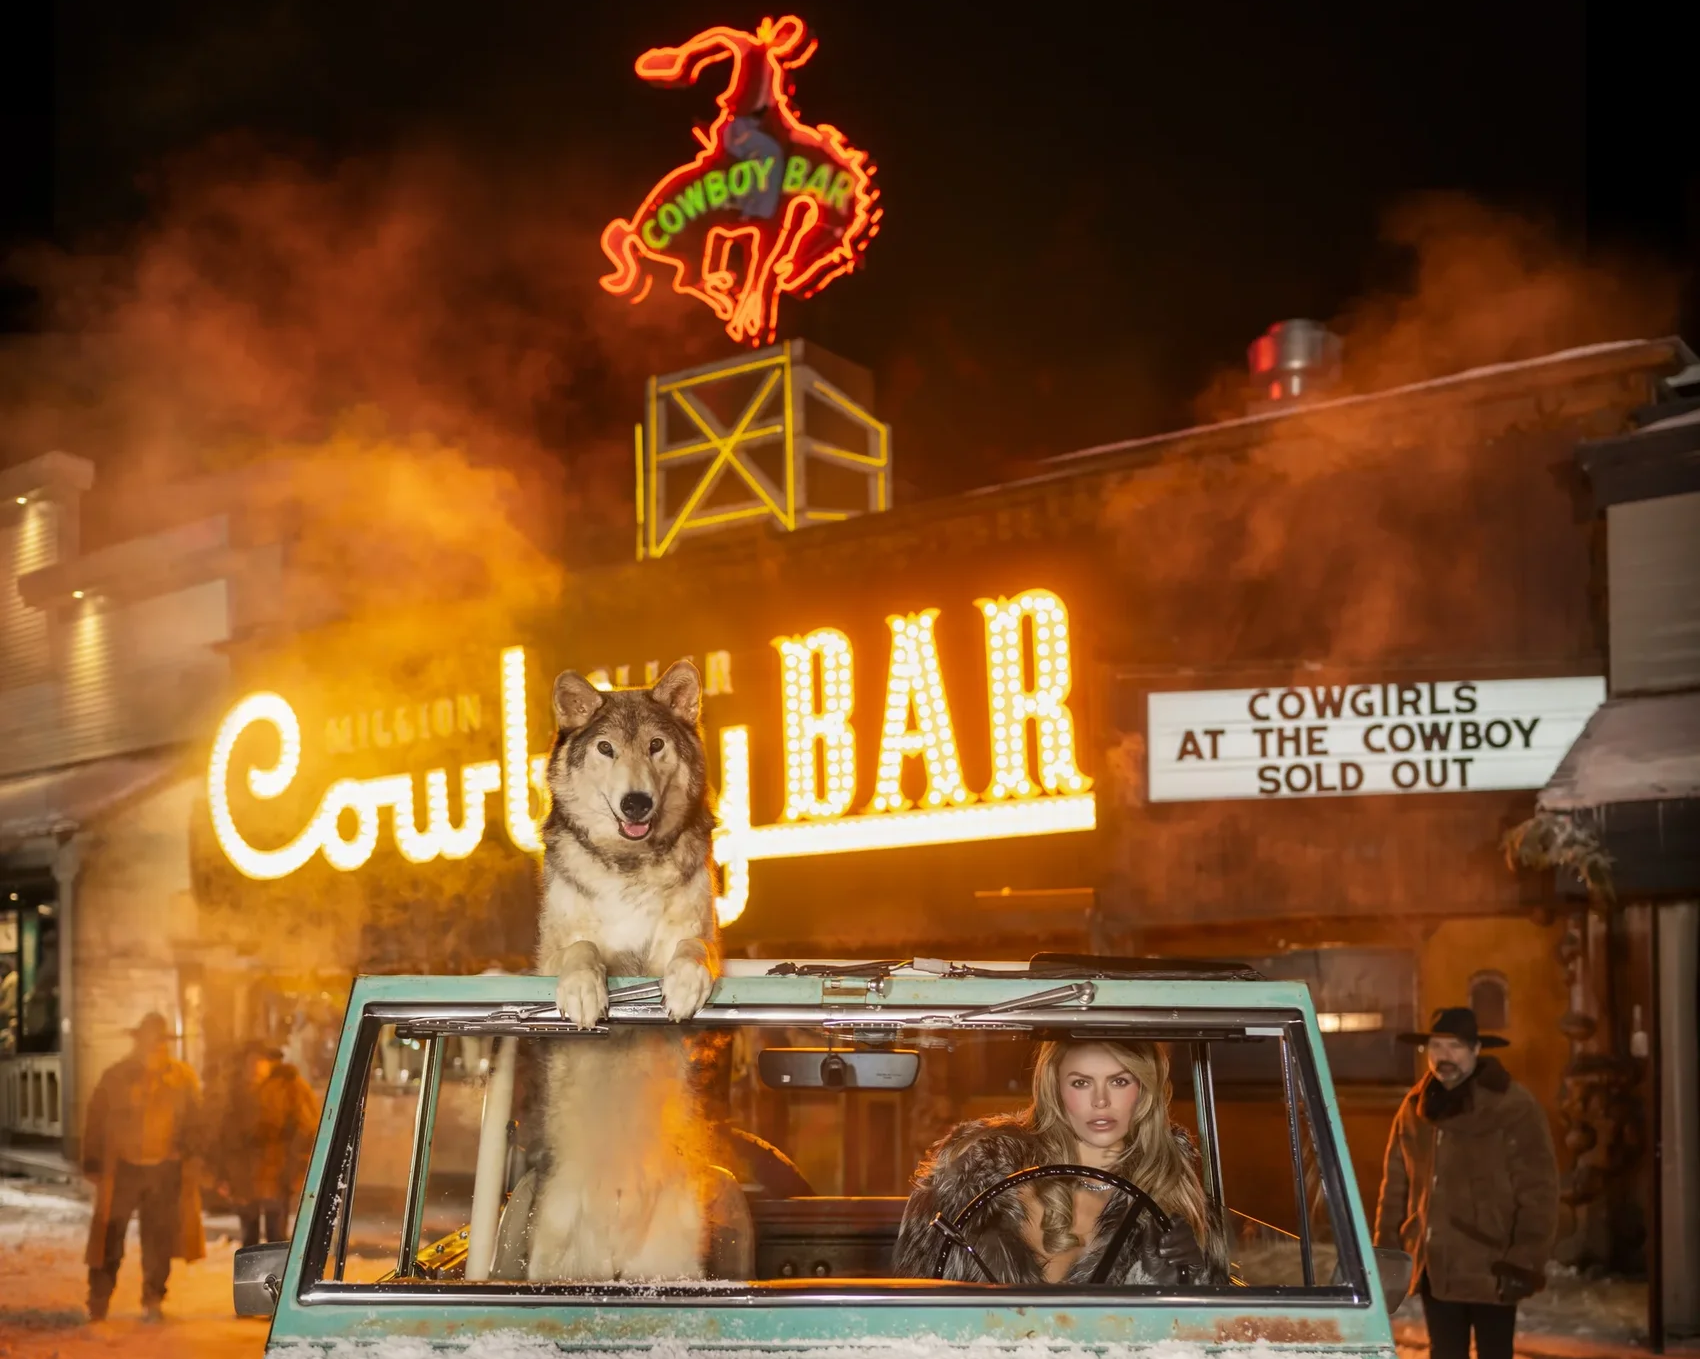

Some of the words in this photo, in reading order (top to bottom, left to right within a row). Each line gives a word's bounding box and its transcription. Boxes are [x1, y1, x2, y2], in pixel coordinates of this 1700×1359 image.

[642, 156, 775, 249] COWBOY
[782, 155, 853, 212] BAR
[1248, 683, 1477, 721] COWGIRLS
[208, 645, 751, 928] Cowby
[770, 588, 1095, 823] BAR
[1176, 729, 1225, 761] AT
[1252, 725, 1329, 758] THE
[1363, 717, 1540, 753] COWBOY
[1257, 761, 1364, 794] SOLD
[1392, 757, 1474, 789] OUT
